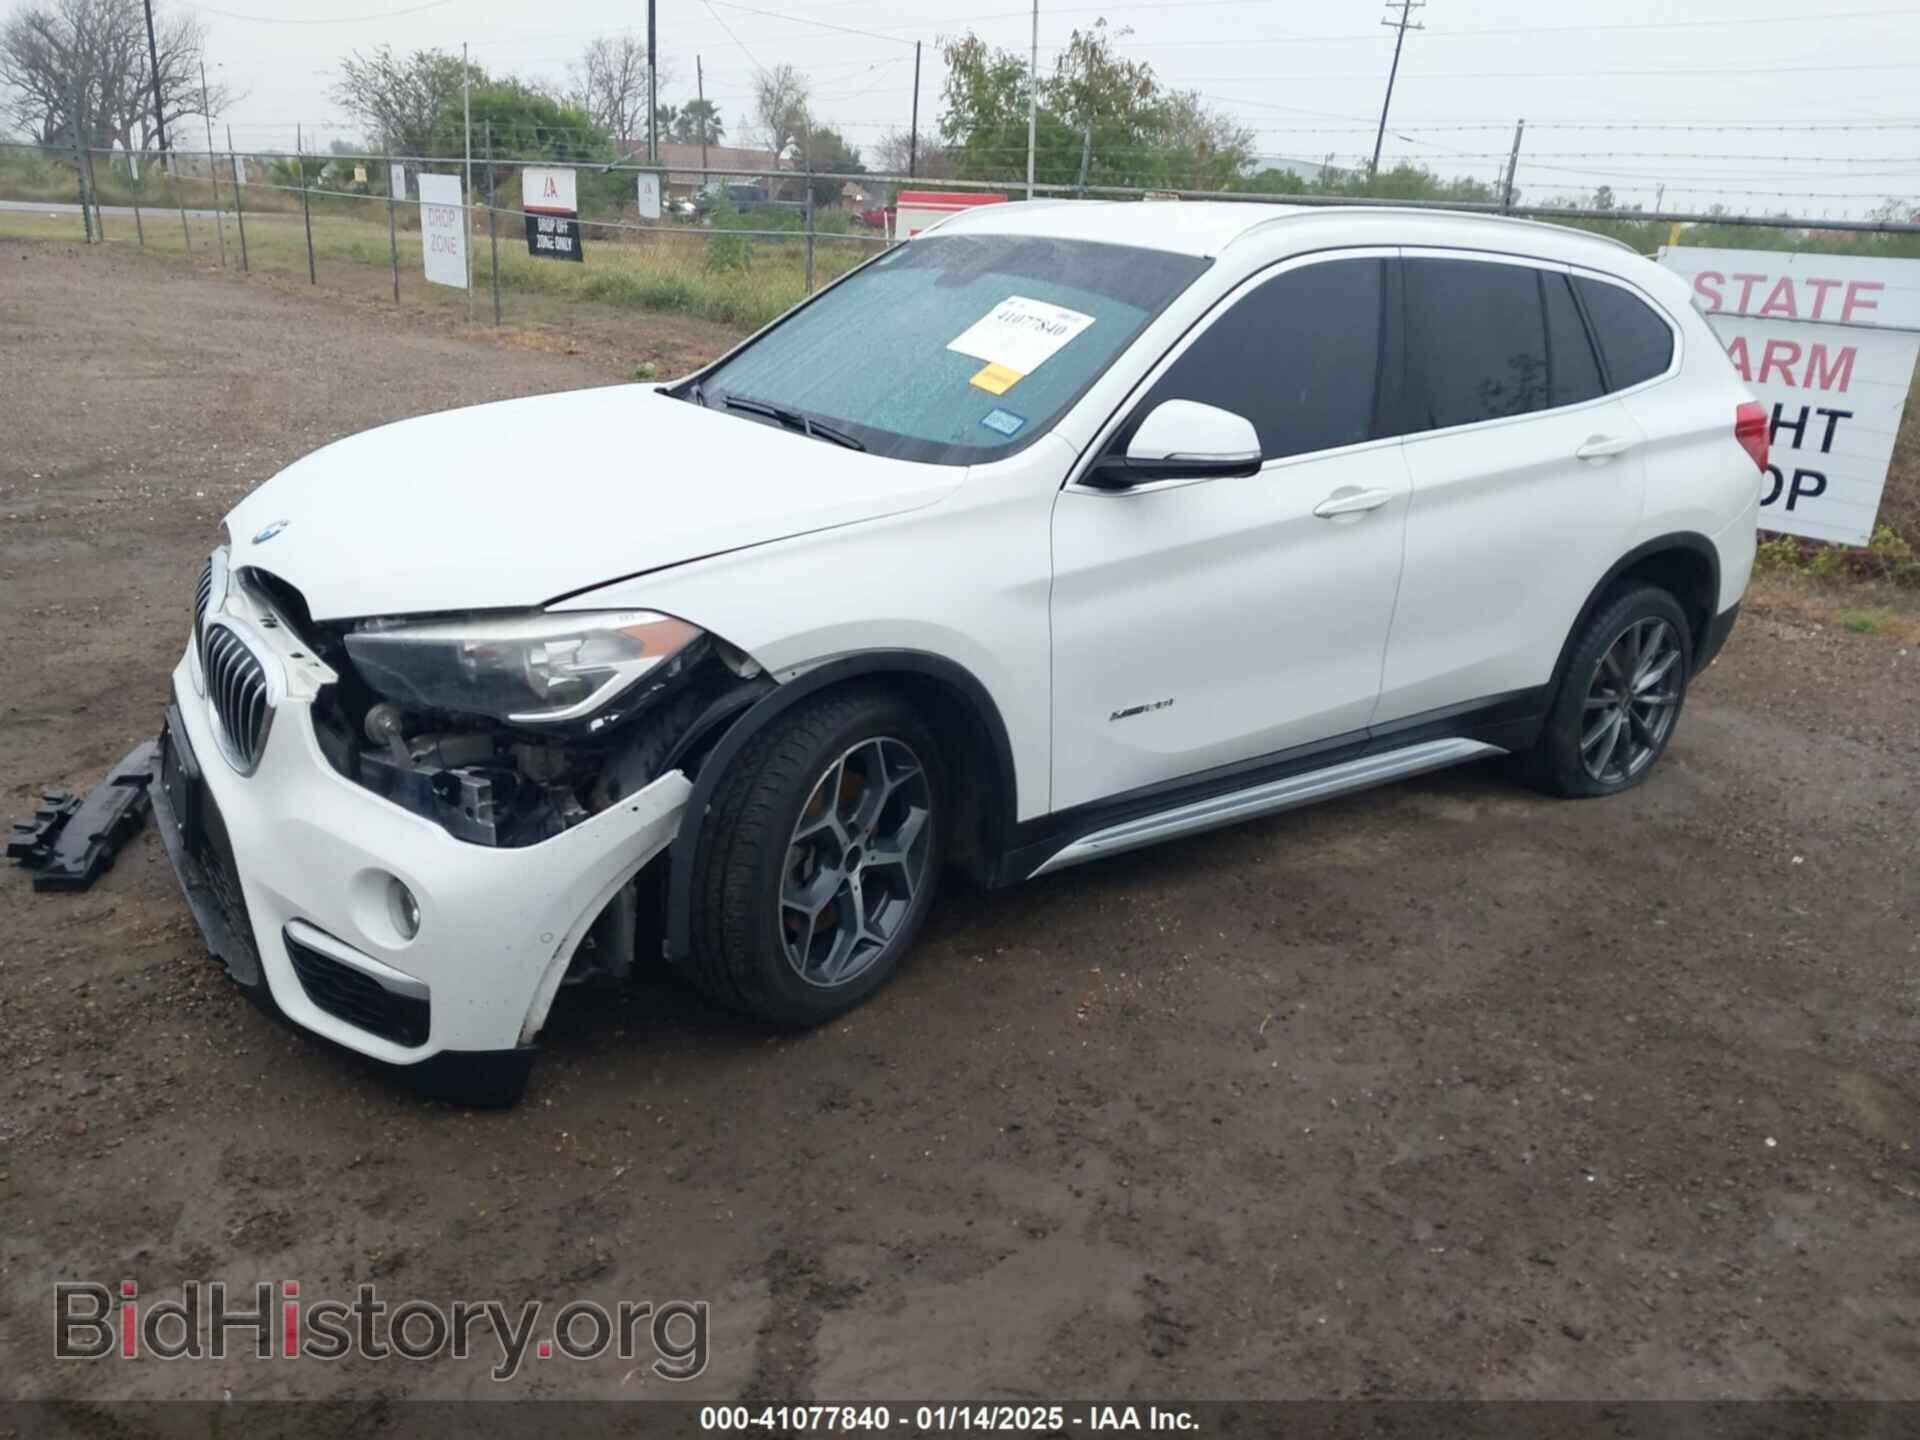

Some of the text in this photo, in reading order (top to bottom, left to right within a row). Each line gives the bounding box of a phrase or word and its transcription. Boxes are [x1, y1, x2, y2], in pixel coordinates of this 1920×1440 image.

[1692, 270, 1885, 324] STATE
[1727, 335, 1858, 393] ARM
[1769, 402, 1854, 454] HT
[1760, 463, 1828, 511] OP
